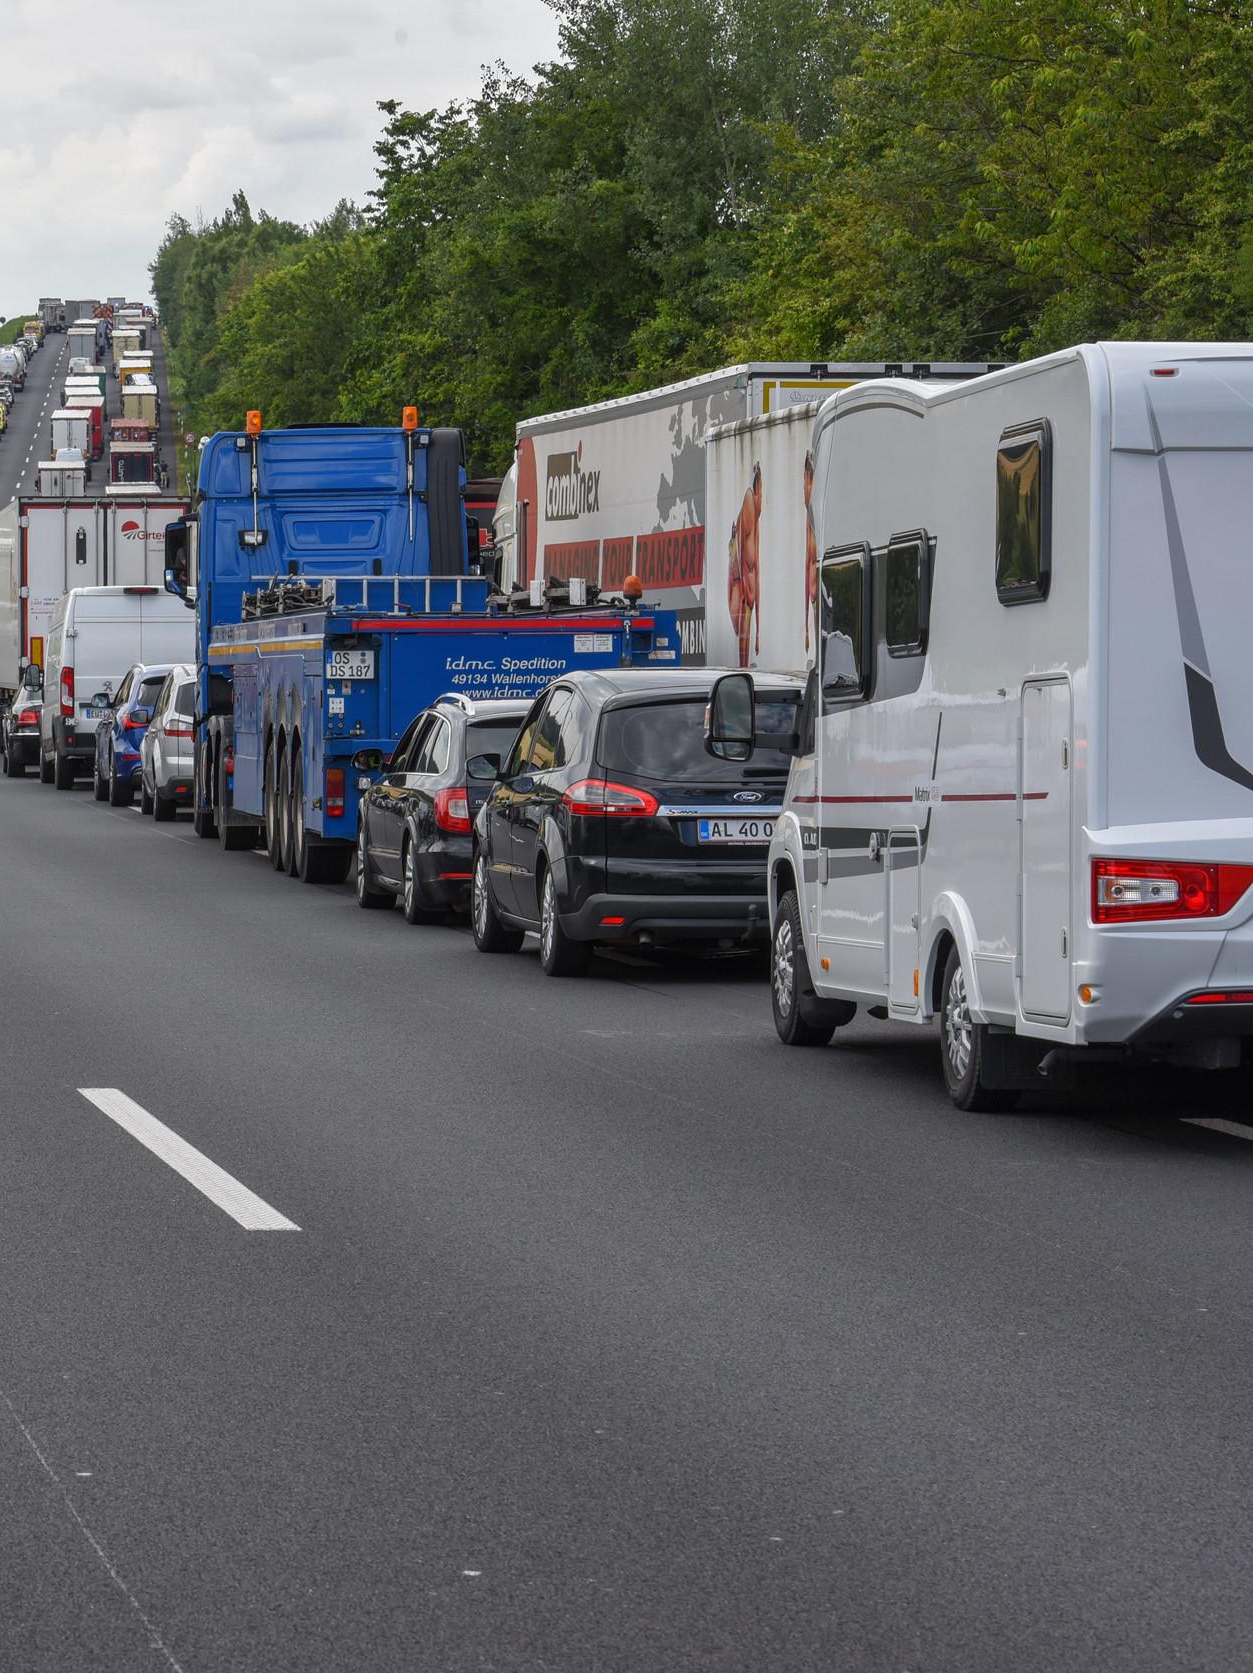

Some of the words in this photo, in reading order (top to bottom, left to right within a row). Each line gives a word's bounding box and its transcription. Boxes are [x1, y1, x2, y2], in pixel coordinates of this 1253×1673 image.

[547, 440, 601, 518] combinex
[603, 543, 634, 586] YOUR
[636, 531, 704, 583] TRANSPORT
[334, 652, 350, 665] OS
[501, 657, 566, 673] Spedition
[330, 665, 346, 677] DS
[348, 664, 370, 677] 187
[452, 674, 487, 685] 49134
[492, 673, 561, 685] Wallenhors
[711, 823, 733, 837] AL
[739, 822, 759, 837] 40
